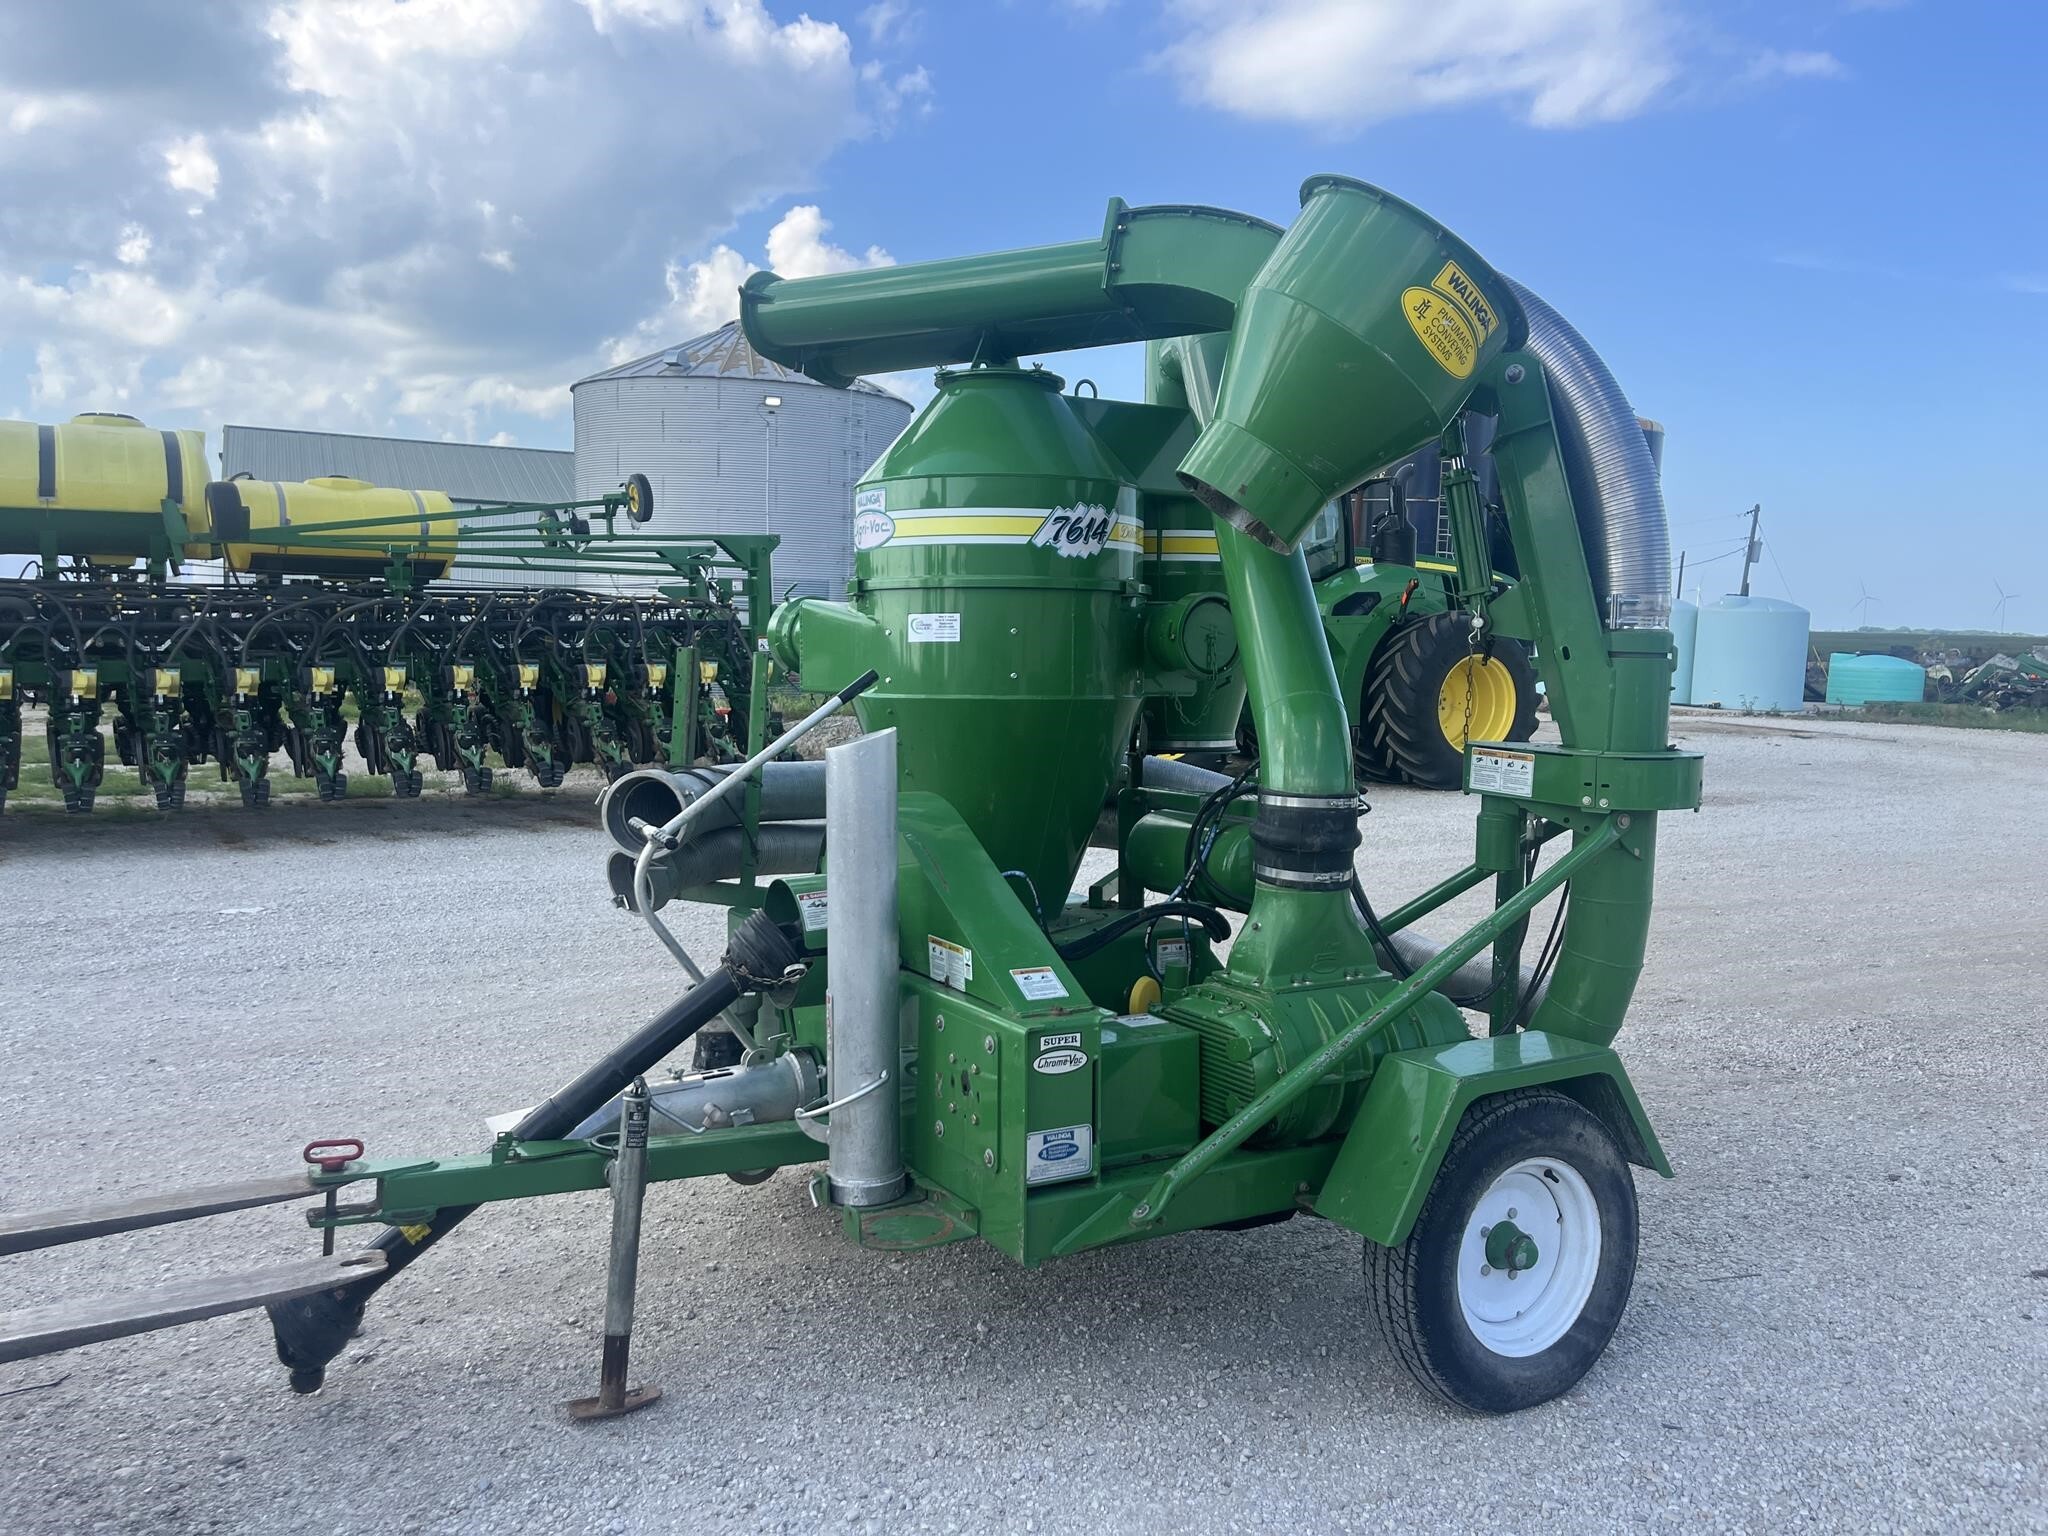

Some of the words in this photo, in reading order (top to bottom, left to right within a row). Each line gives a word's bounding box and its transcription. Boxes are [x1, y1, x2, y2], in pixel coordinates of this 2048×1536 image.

[1448, 271, 1492, 330] WALINGA
[1423, 325, 1453, 361] SYSTEMS
[1431, 317, 1468, 365] CONVEYING
[1438, 307, 1473, 354] PNEUMATIC
[1050, 515, 1109, 546] 7614
[1043, 1035, 1078, 1047] SUPER
[1037, 1053, 1084, 1069] Chrome-Vac
